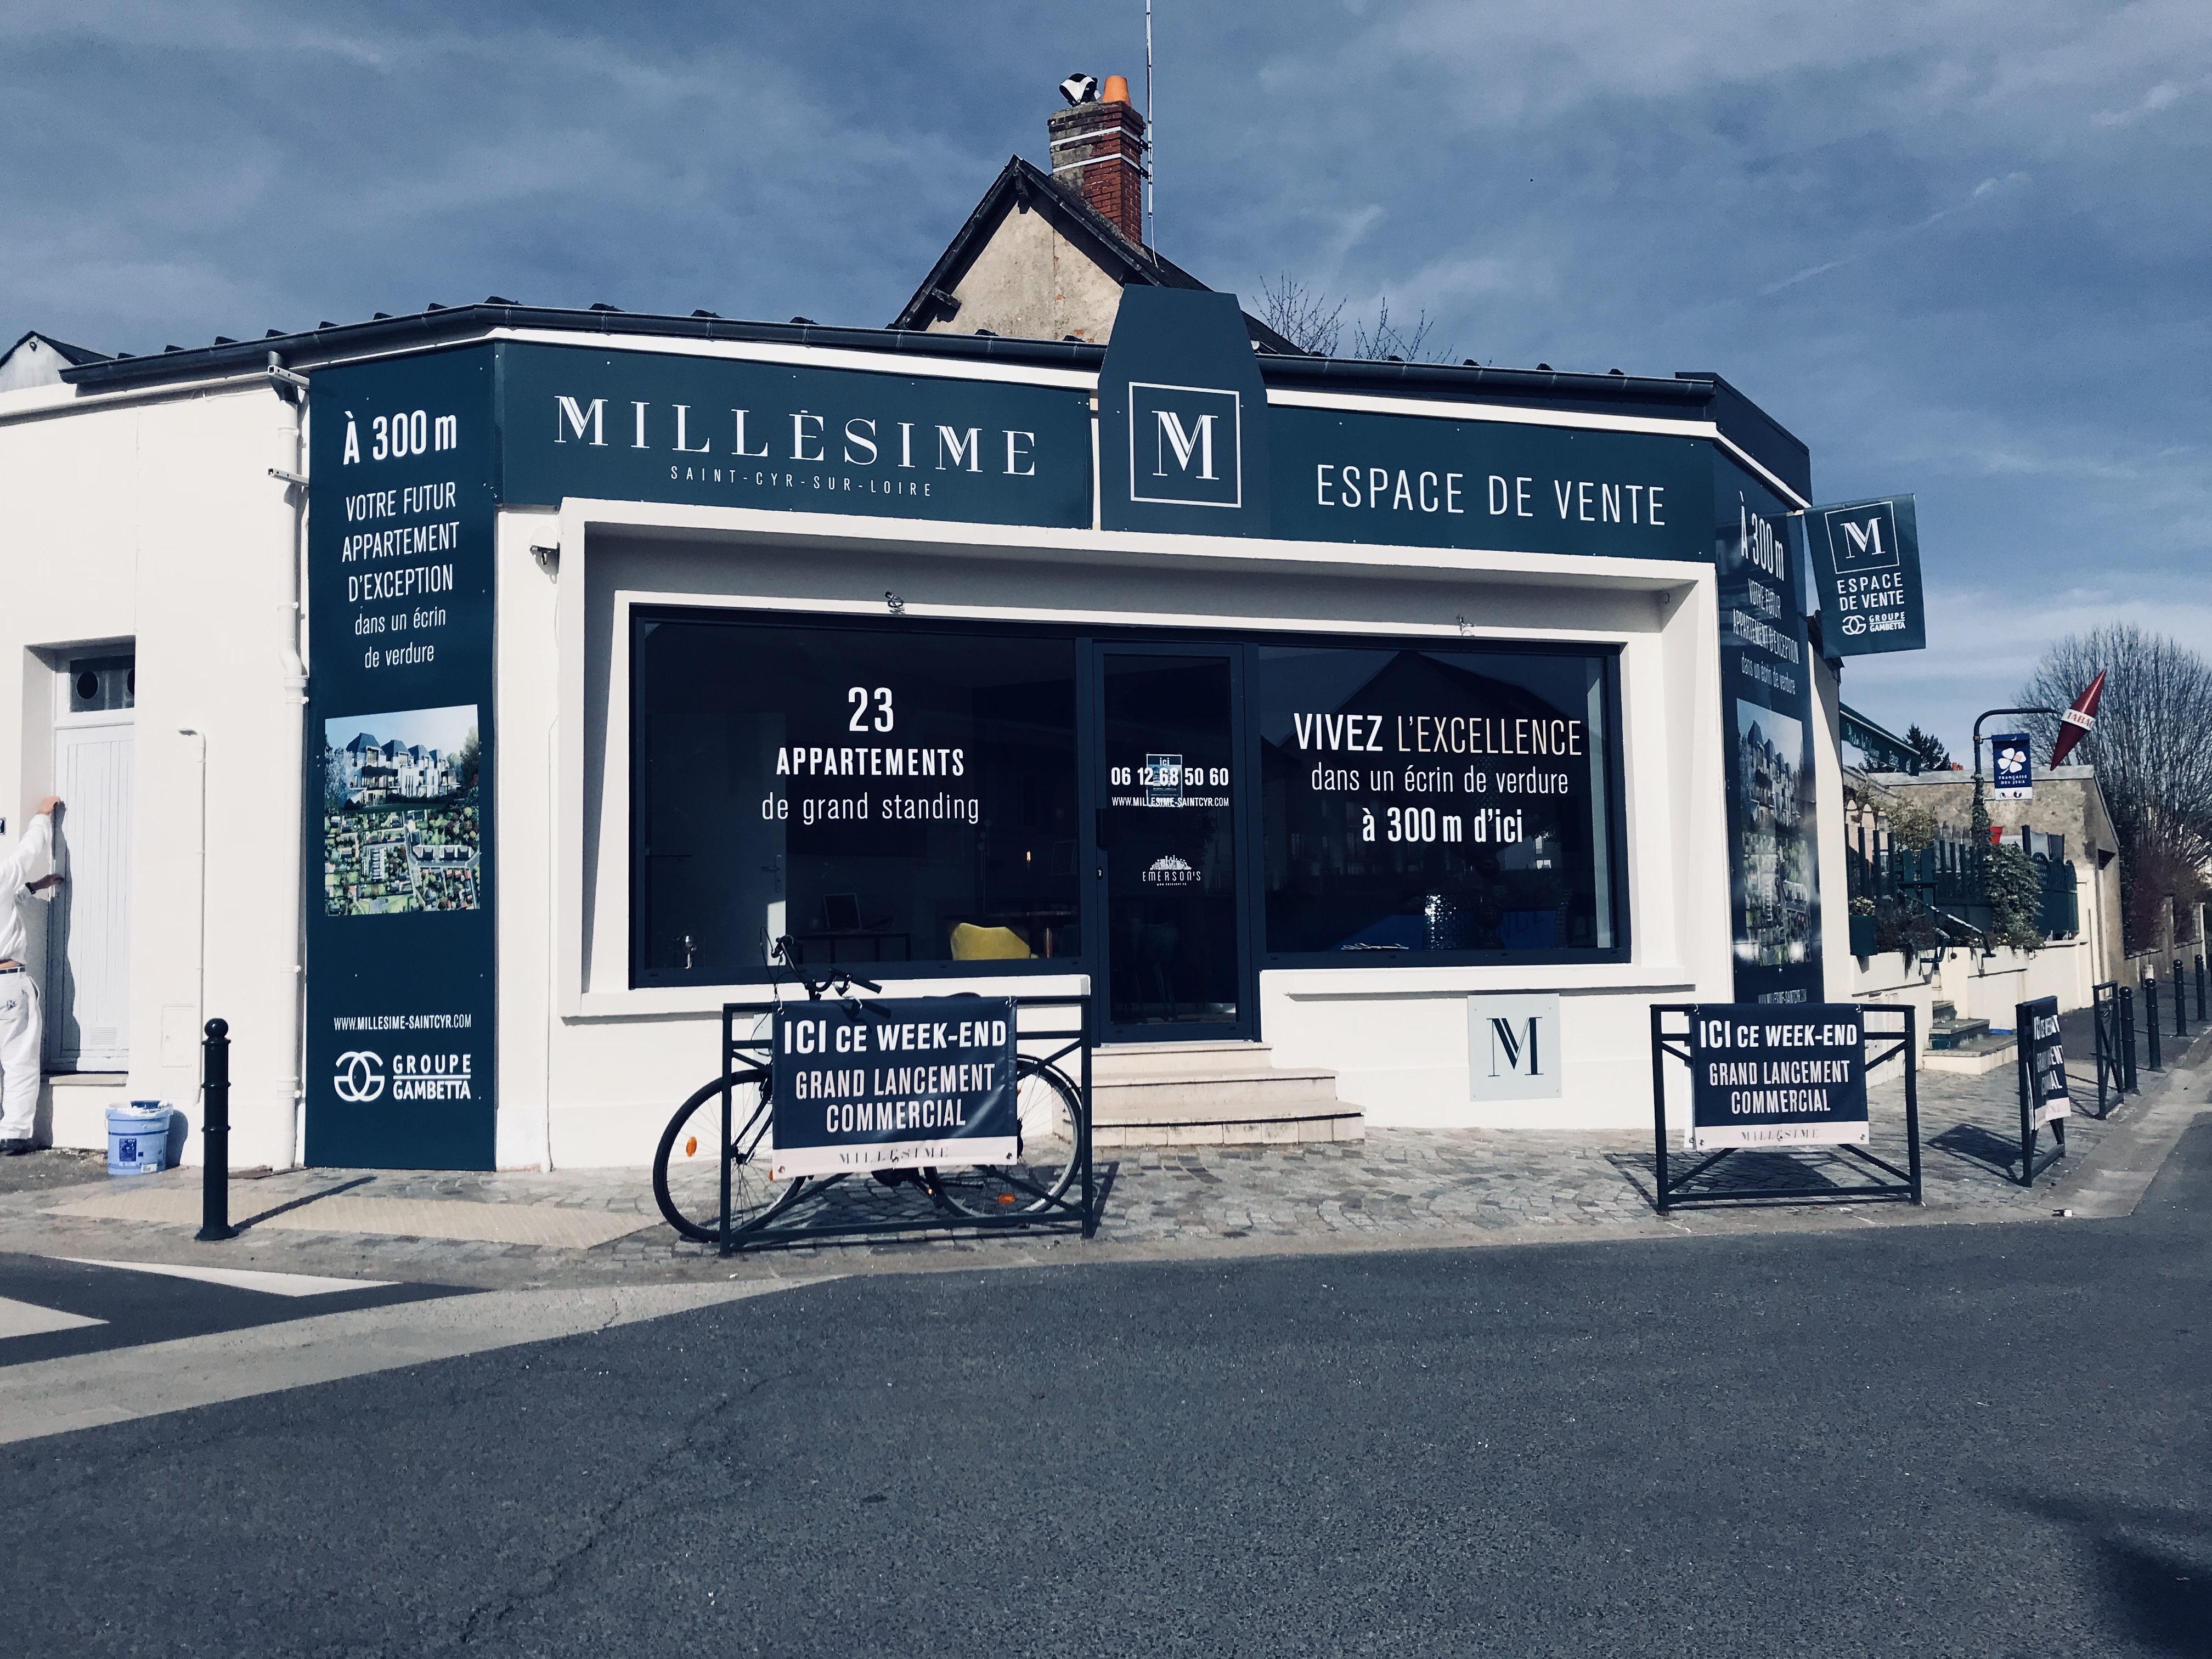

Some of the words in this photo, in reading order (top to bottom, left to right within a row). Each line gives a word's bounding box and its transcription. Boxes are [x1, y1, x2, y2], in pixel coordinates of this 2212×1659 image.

[343, 411, 360, 465] À
[1152, 411, 1219, 479] M
[670, 465, 932, 496] SAINT-CYR-SUR-LOIRE
[1318, 465, 1464, 513] ESPACE
[1489, 476, 1533, 516] DE
[1555, 480, 1664, 525] VENTE
[346, 490, 396, 521] VOTRE
[404, 482, 455, 514] FUTUR
[1739, 490, 1749, 560] À
[1840, 517, 1885, 559] M
[342, 522, 460, 563] APPARTEMENT
[349, 564, 452, 602] D'EXCEPTION
[1837, 572, 1903, 594] ESPACE
[1839, 595, 1858, 611] DE
[1861, 589, 1905, 608] VENTE
[356, 613, 385, 635] dans
[392, 614, 406, 630] un
[414, 606, 445, 628] écrin
[1869, 611, 1905, 623] GROUPE
[1870, 622, 1906, 632] GAMBETTA
[365, 647, 379, 668] de
[386, 642, 433, 665] verdure
[849, 687, 893, 732] 23
[1294, 713, 1383, 751] VIVEZ
[1398, 716, 1581, 755] L'EXCELLENCE
[776, 748, 963, 776] APPARTEMENTS
[1111, 767, 1131, 786] 06
[1137, 767, 1153, 786] 12
[1159, 767, 1178, 786] 68
[1184, 768, 1204, 786] 50
[1210, 768, 1229, 786] 60
[1159, 757, 1170, 766] ici
[1312, 762, 1359, 790] dans
[1371, 771, 1393, 791] un
[1405, 765, 1453, 792] écrin
[1465, 765, 1486, 792] de
[1496, 766, 1567, 793] verdure
[763, 792, 788, 819] de
[804, 792, 867, 825] grand
[882, 792, 978, 824] standing
[1112, 797, 1229, 807] WWW.MILLESIME-SAINTCYR.COM
[1362, 808, 1375, 841] à
[1475, 809, 1522, 842] d'ici
[1142, 871, 1201, 881] EMERSON'S
[334, 1014, 472, 1031] WWW.MILLESIME-SAINTCYR.COM
[785, 1020, 826, 1054] ICI
[836, 1025, 866, 1052] CE
[877, 1021, 1006, 1051] WEEK-END
[1701, 1020, 1730, 1048] ICI
[1737, 1026, 1759, 1047] CE
[1765, 1025, 1857, 1046] WEEK-END
[1486, 1017, 1544, 1077] M
[393, 1054, 471, 1074] GROUPE
[1709, 1063, 1757, 1086] GRAND
[1764, 1060, 1849, 1084] LANCEMENT
[393, 1080, 471, 1100] GAMBETTA
[796, 1070, 864, 1099] GRAND
[874, 1064, 995, 1096] LANCEMENT
[827, 1099, 966, 1132] COMMERCIAL
[1732, 1089, 1830, 1114] COMMERCIAL
